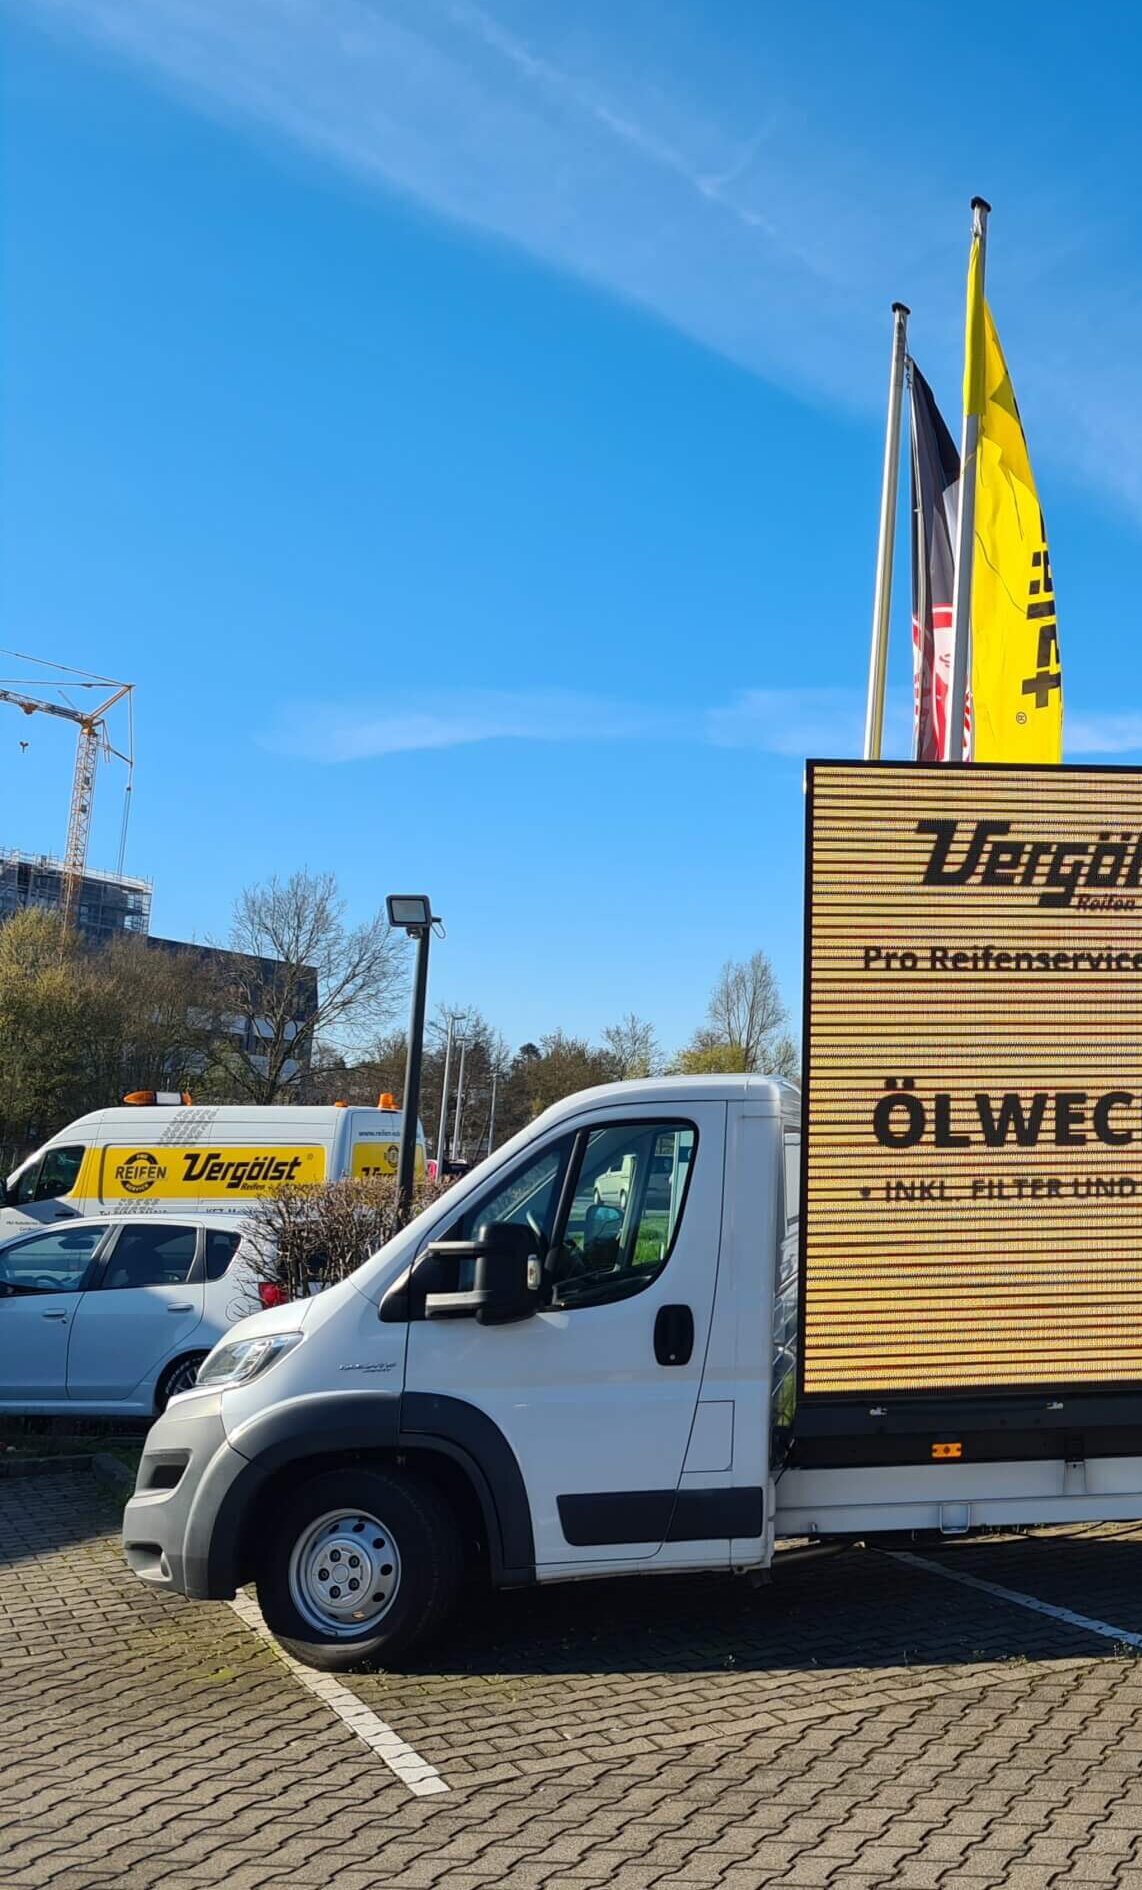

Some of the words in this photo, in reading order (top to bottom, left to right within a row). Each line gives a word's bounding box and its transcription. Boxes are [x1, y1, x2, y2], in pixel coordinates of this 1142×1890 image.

[1076, 894, 1136, 912] Reifen
[863, 946, 918, 971] Pro
[115, 1165, 167, 1180] REIFEN
[182, 1153, 302, 1189] Vergölst
[886, 1179, 961, 1202] INKL.
[972, 1178, 1062, 1200] FILTER
[1073, 1177, 1136, 1199] UND
